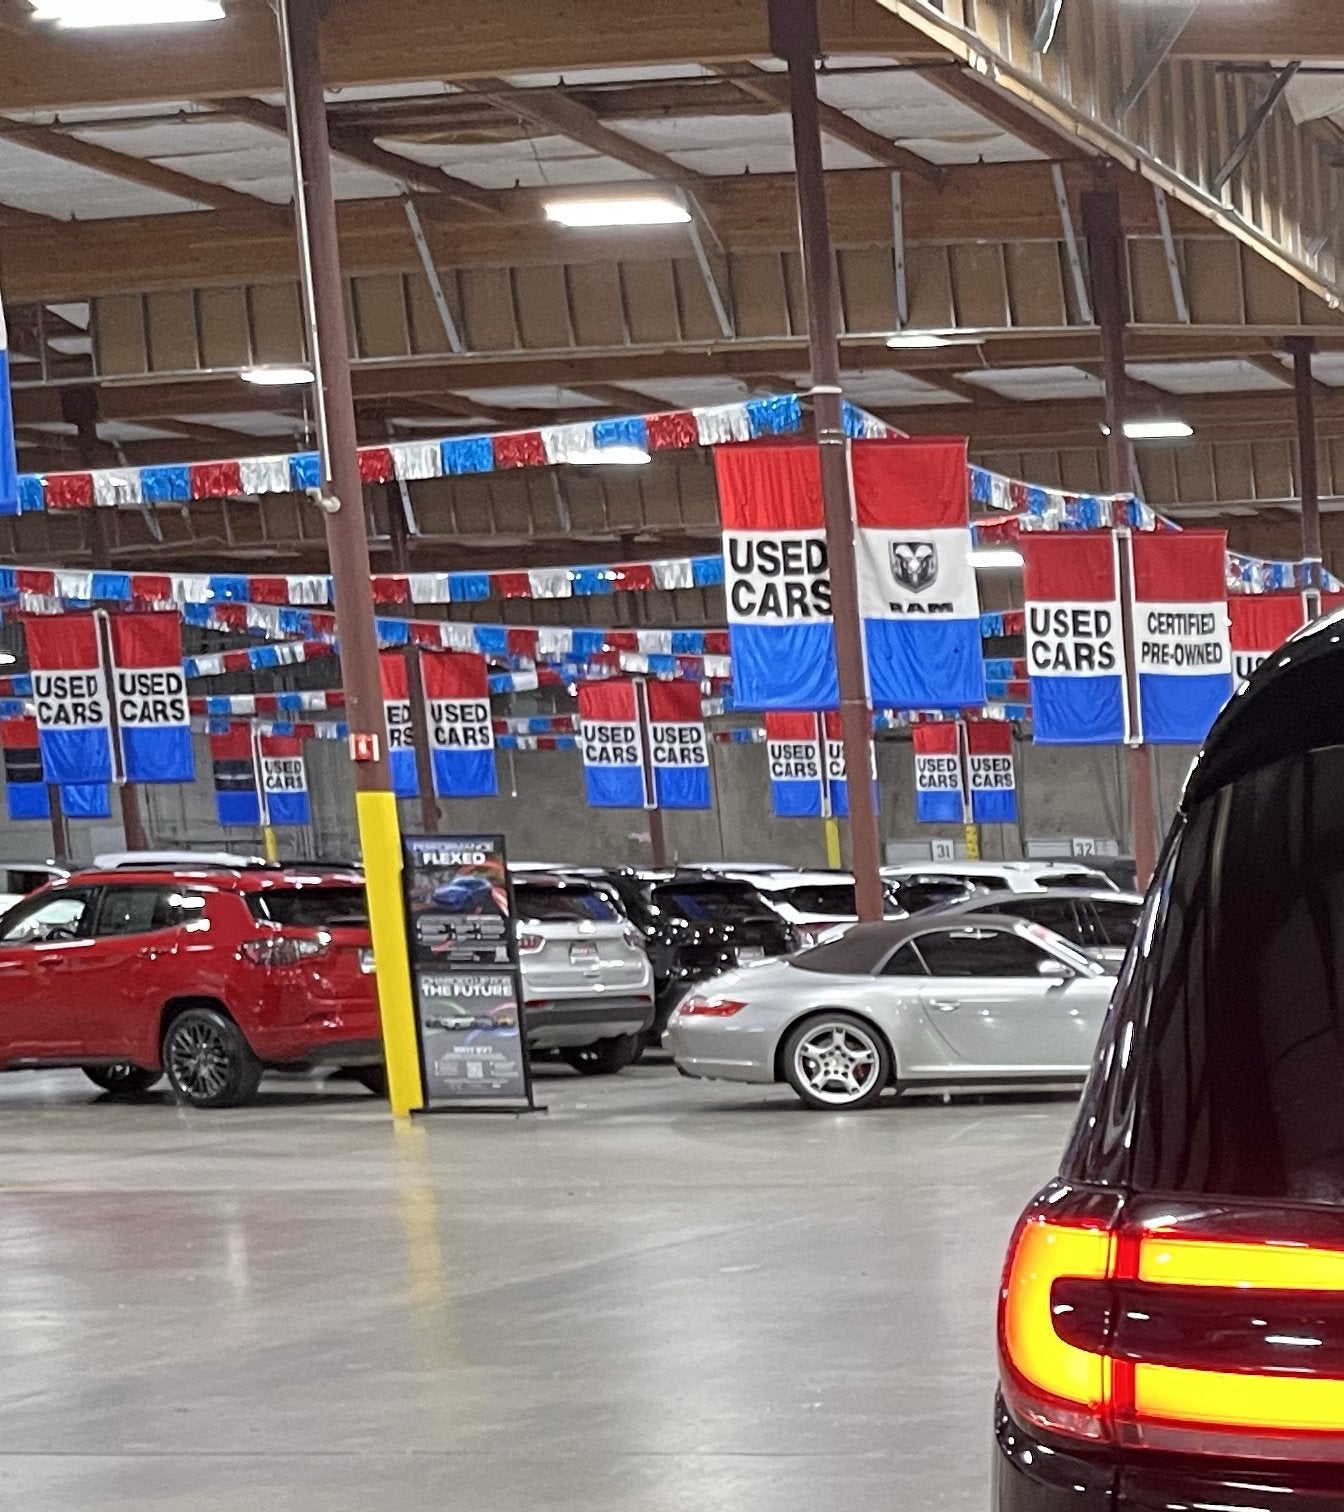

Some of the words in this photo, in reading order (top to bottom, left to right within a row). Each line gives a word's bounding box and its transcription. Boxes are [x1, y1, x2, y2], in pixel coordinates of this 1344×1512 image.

[729, 538, 828, 577] USED
[731, 579, 832, 618] CARS
[1030, 607, 1112, 638] USED
[1147, 612, 1216, 635] CERTIFIED
[1031, 640, 1115, 671] CARS
[1141, 642, 1223, 666] PRE-OWNED
[35, 674, 98, 699] USED
[119, 673, 183, 697] USED
[38, 701, 103, 725] CARS
[120, 699, 185, 723] CARS
[387, 705, 411, 724] ED
[431, 703, 487, 723] USED
[390, 727, 413, 746] RS
[435, 726, 490, 746] CARS
[584, 725, 635, 744] USED
[653, 725, 701, 744] USED
[586, 745, 638, 764] CARS
[653, 745, 705, 764] CARS
[771, 744, 816, 760] USED
[265, 760, 302, 774] USED
[772, 761, 818, 778] CARS
[918, 758, 957, 772] USED
[971, 758, 1011, 772] USED
[266, 776, 303, 789] CARS
[919, 773, 958, 788] CARS
[972, 773, 1013, 788] CARS
[423, 852, 486, 866] FLEXED
[937, 844, 951, 858] 31
[423, 984, 451, 996] THE
[454, 984, 512, 996] FUTURE
